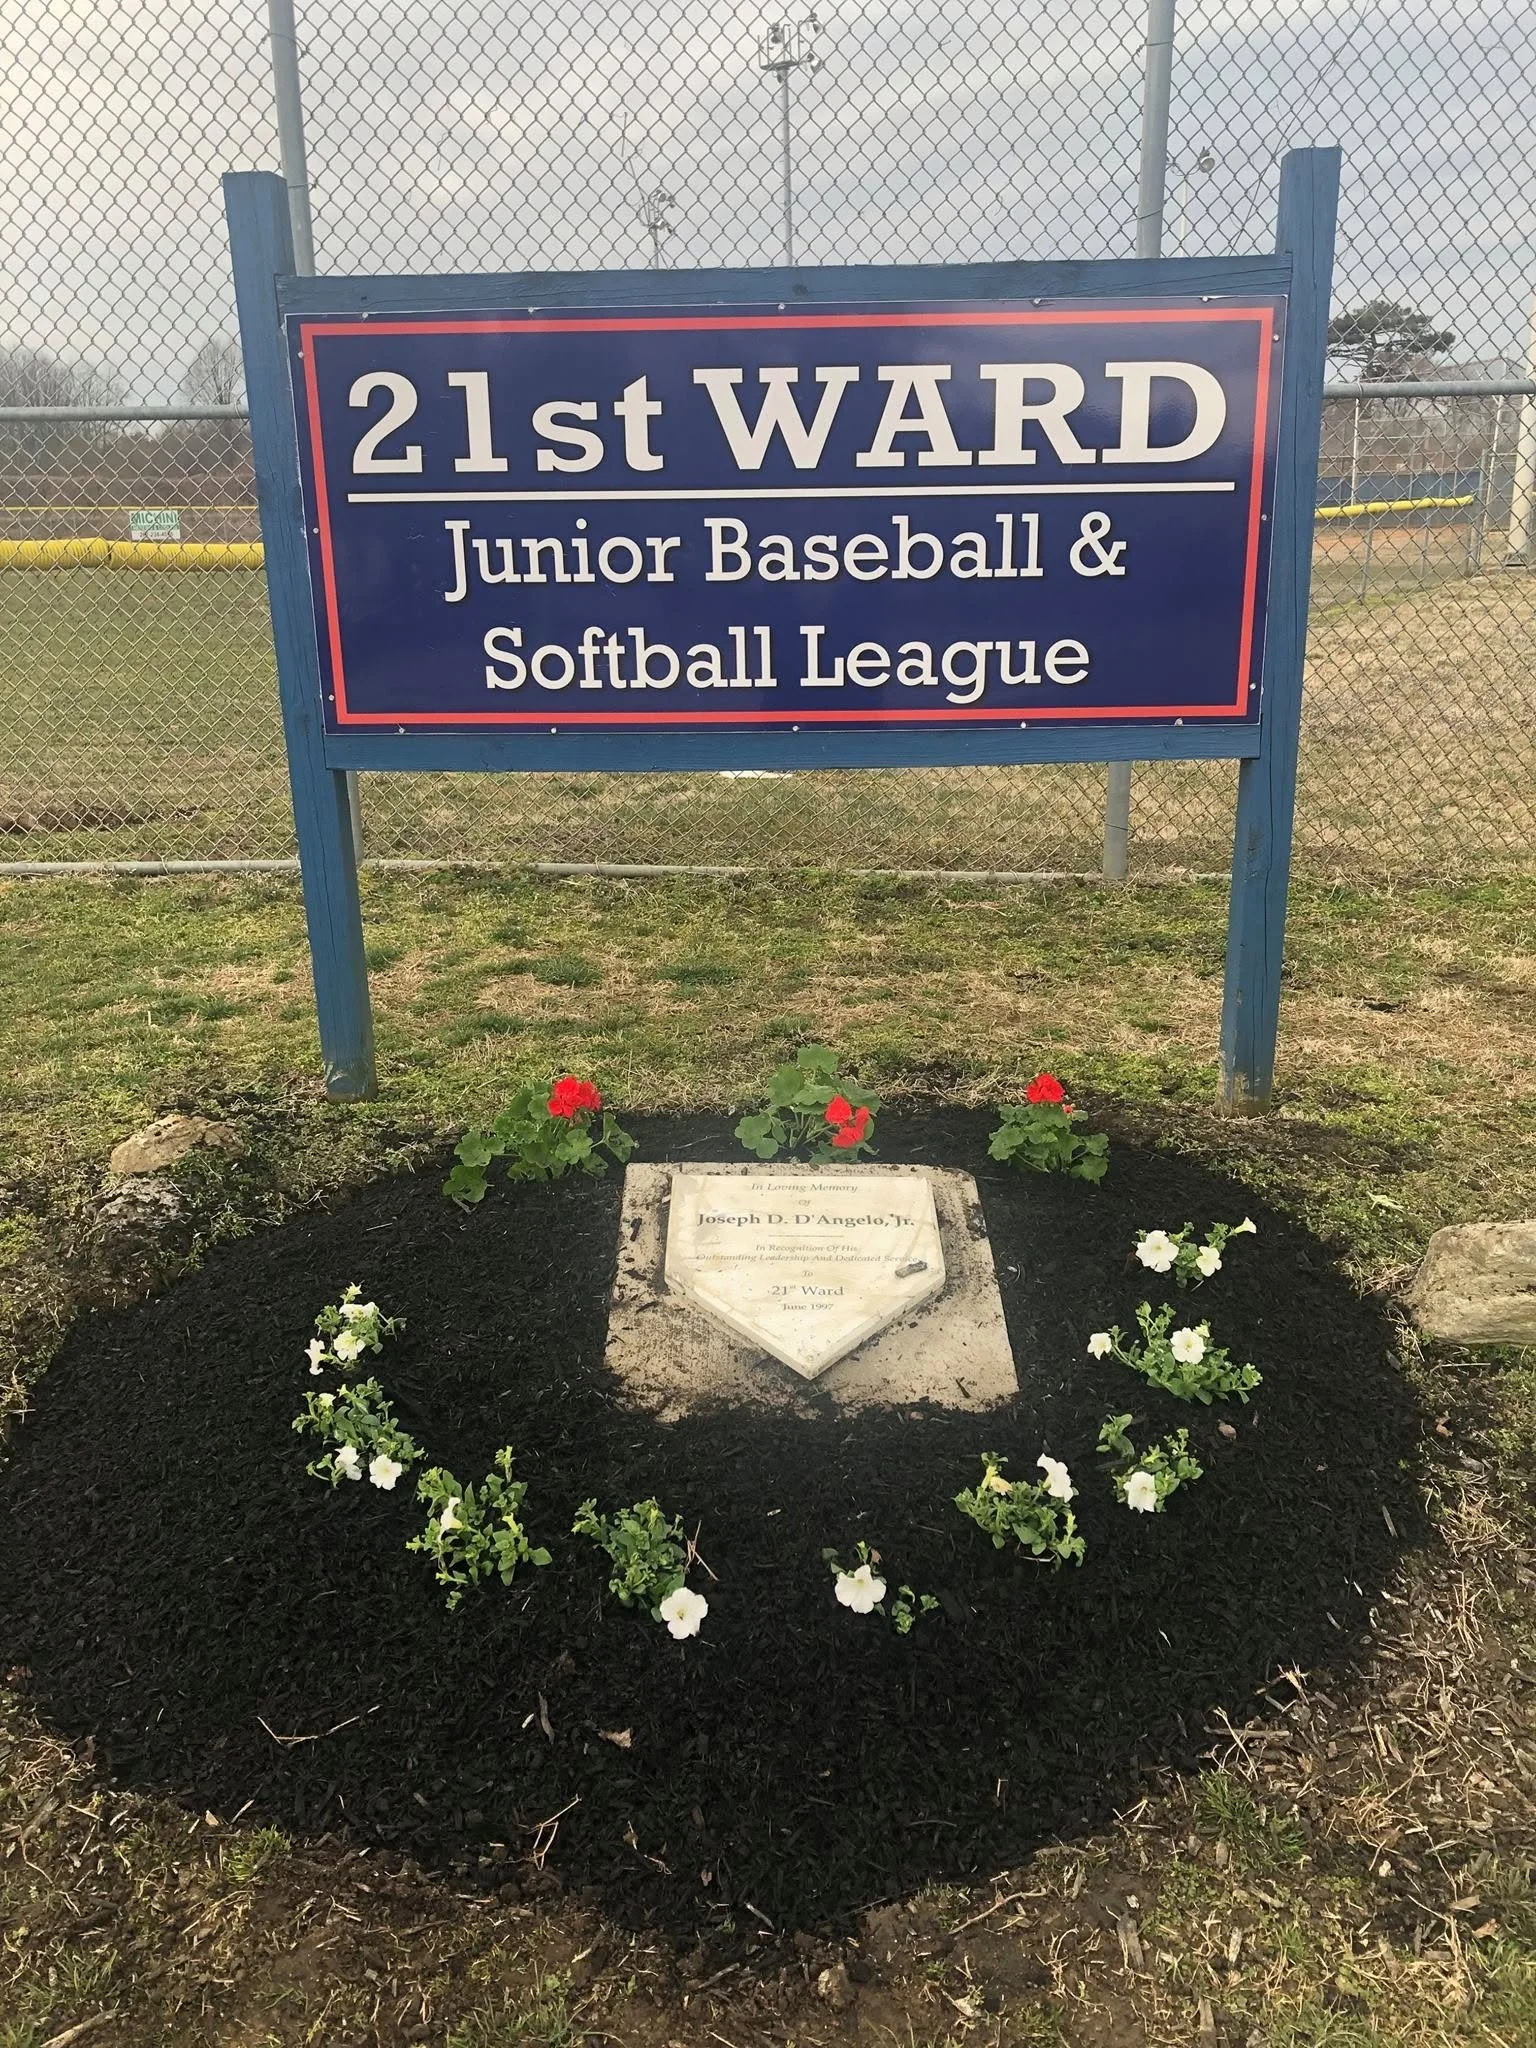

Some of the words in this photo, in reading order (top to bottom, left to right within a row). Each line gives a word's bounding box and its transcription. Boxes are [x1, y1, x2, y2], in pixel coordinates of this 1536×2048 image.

[349, 372, 663, 473] 21st
[693, 362, 1226, 469] WARD
[445, 519, 680, 601] Junior
[704, 513, 1043, 581] Baseball
[1070, 512, 1126, 576] &
[484, 626, 777, 689] Softball
[800, 626, 1089, 703] League
[751, 1183, 764, 1191] In
[767, 1184, 806, 1192] Loving
[810, 1184, 858, 1193] Memory
[699, 1214, 760, 1226] Joseph
[768, 1214, 788, 1225] D.
[795, 1214, 890, 1228] D'Angelo,
[894, 1215, 914, 1227] Jr.
[768, 1244, 824, 1252] Recognition
[826, 1244, 840, 1252] Of
[697, 1254, 757, 1262] Outstanding
[759, 1254, 810, 1263] Leadership
[812, 1254, 832, 1262] And
[836, 1254, 881, 1262] Dedicated
[772, 1284, 797, 1296] 21st
[802, 1286, 844, 1296] Ward
[782, 1303, 808, 1312] June
[811, 1303, 834, 1311] 1997
